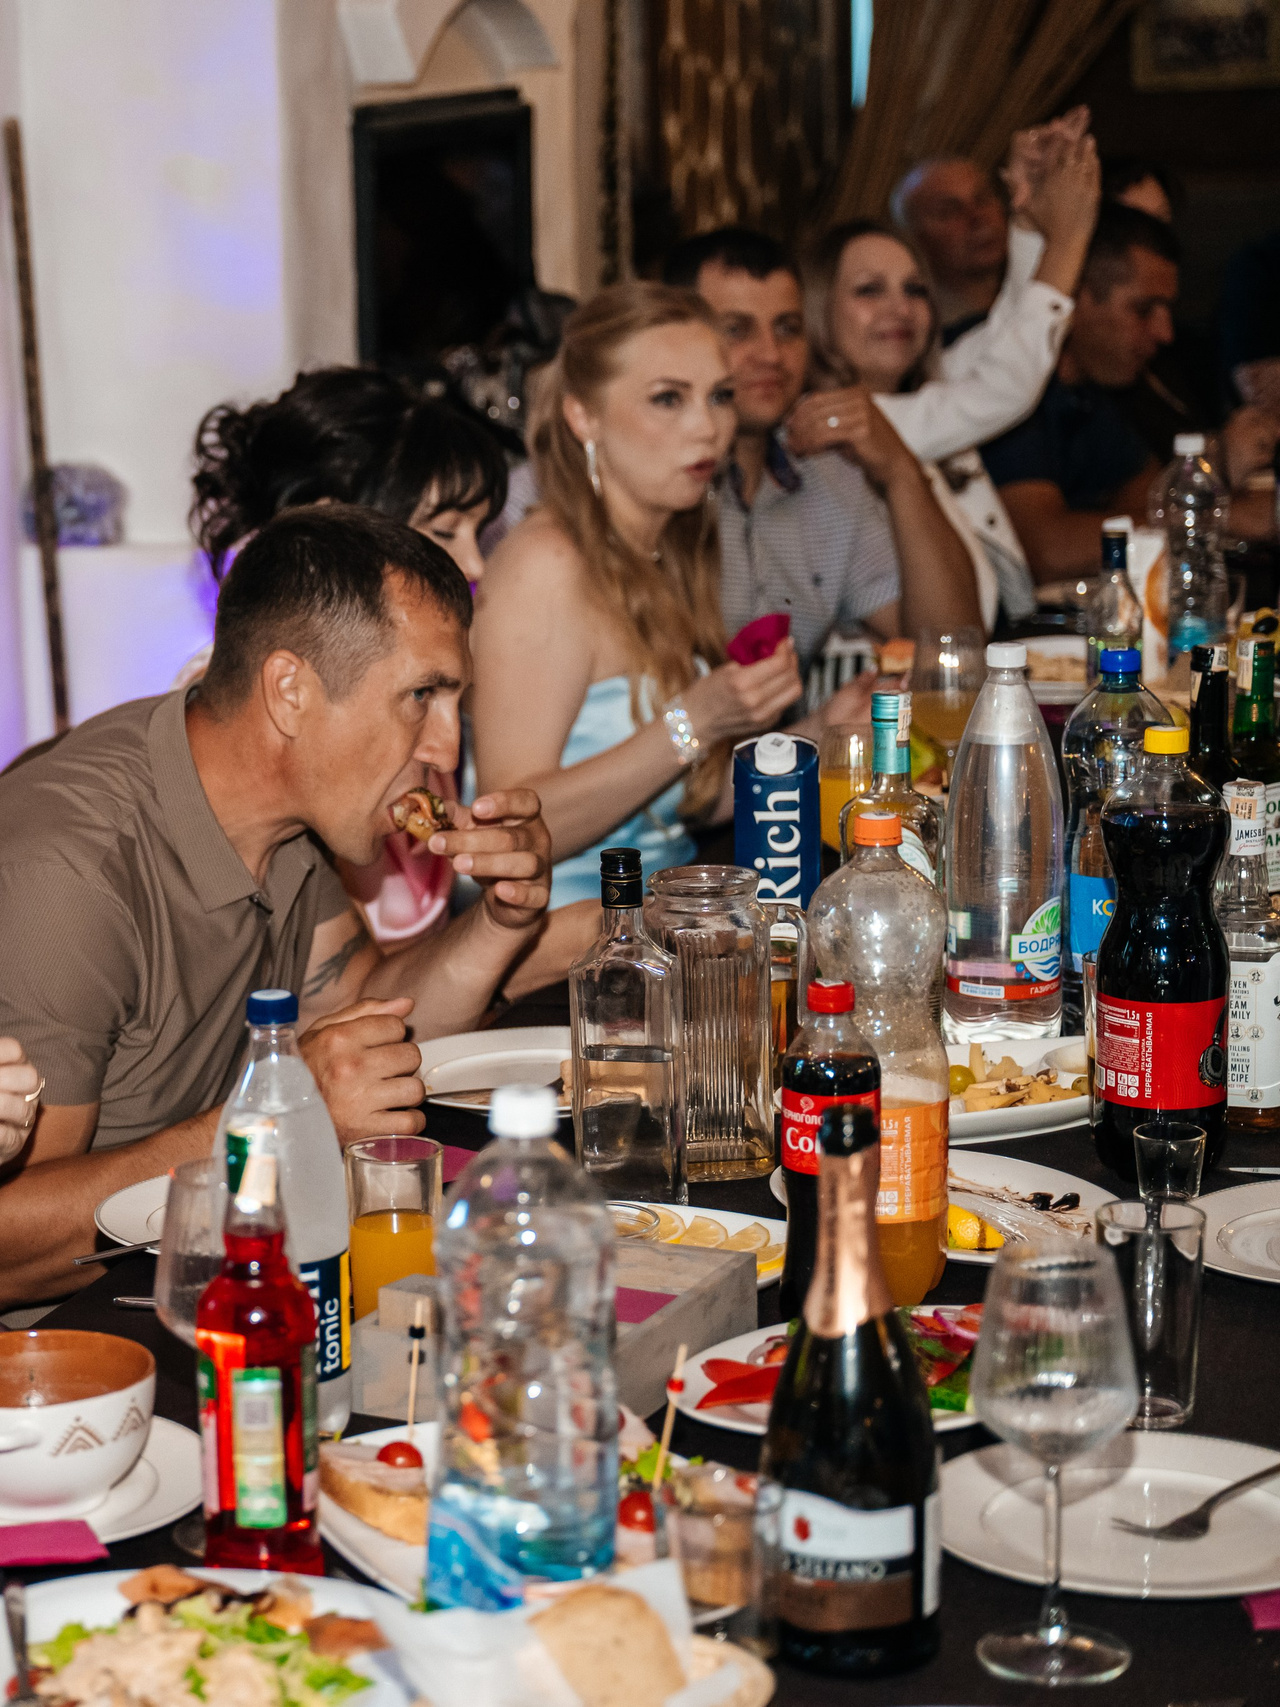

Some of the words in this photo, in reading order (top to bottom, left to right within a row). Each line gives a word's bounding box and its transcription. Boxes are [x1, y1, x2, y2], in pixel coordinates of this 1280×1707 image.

[1235, 828, 1257, 841] JAMES
[753, 787, 801, 908] Rich
[1230, 980, 1247, 989] VEN
[1229, 1000, 1247, 1009] EAM
[1231, 1010, 1251, 1020] MILY
[1145, 1012, 1153, 1098] ПЕРЕРАБАТЫВАЕМАЯ
[1230, 1063, 1250, 1073] MILY
[1230, 1073, 1249, 1083] CIPE
[785, 1126, 822, 1154] Col
[904, 1116, 912, 1215] ПЕРЕРАБАТЫВАЕМАЯ
[320, 1298, 339, 1373] tonic
